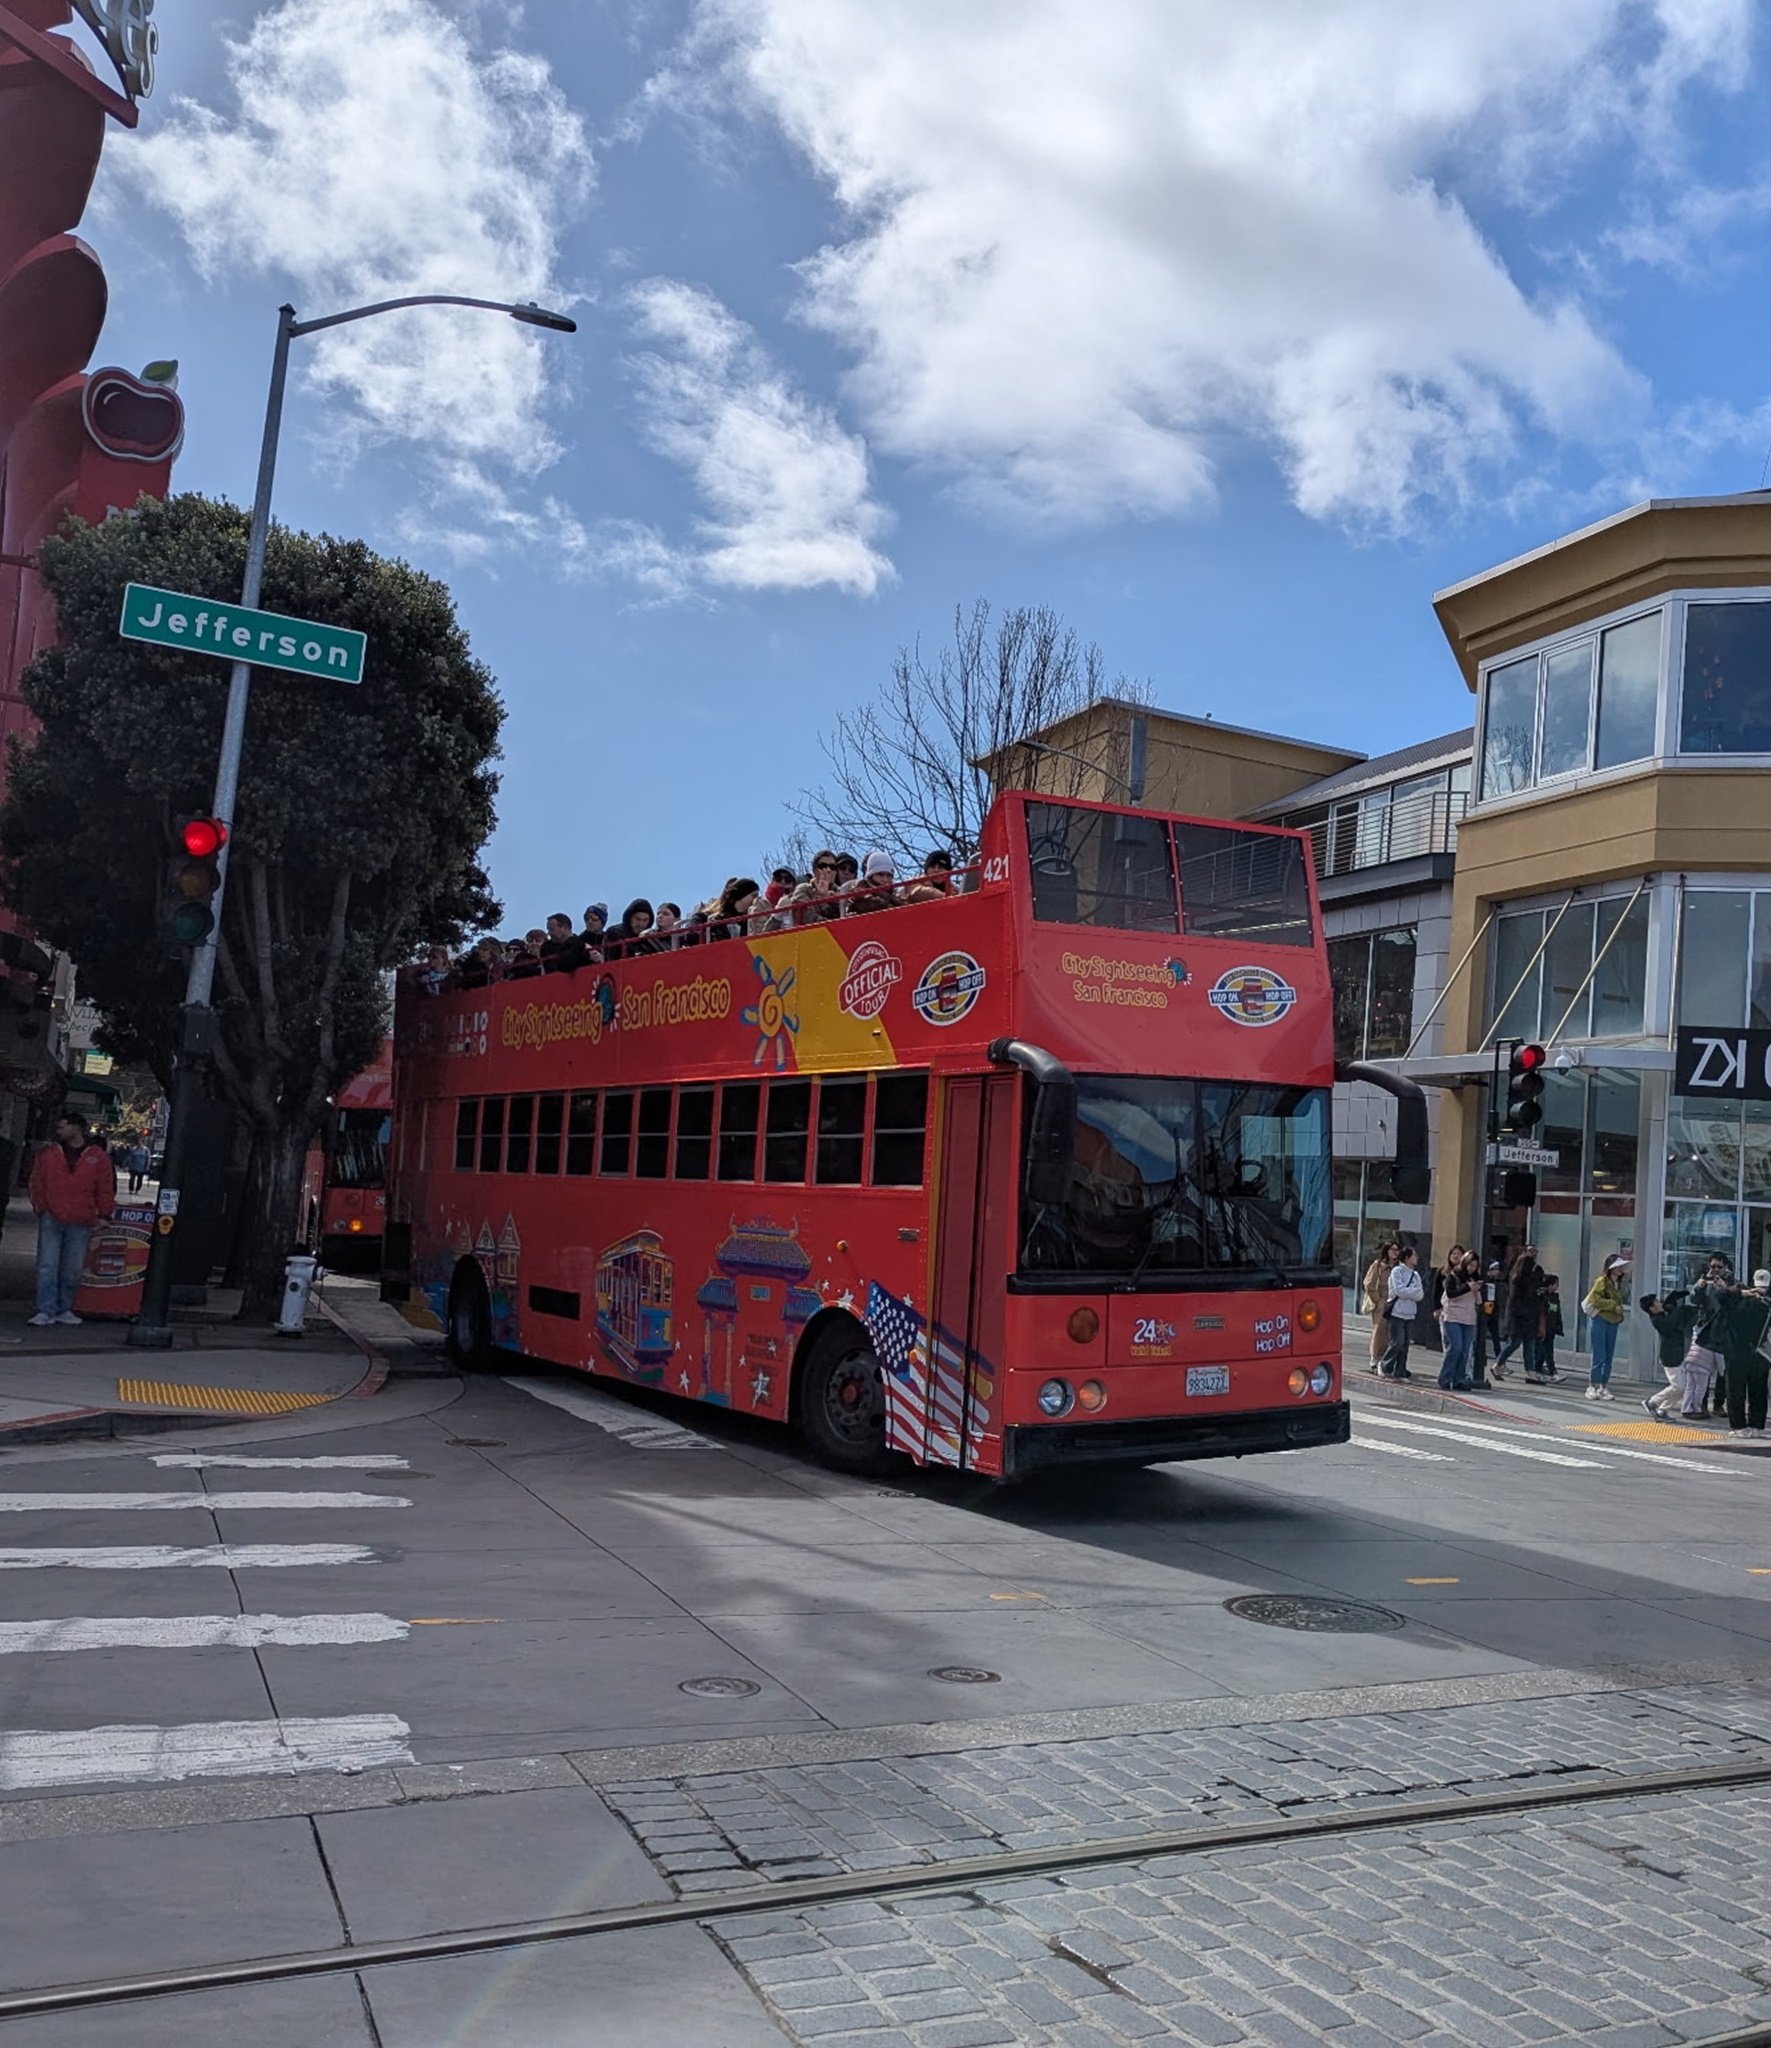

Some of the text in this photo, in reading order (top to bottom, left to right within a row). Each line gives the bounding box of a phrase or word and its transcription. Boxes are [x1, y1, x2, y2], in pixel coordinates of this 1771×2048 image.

[138, 603, 349, 668] Jefferson
[983, 853, 1009, 882] 421
[844, 960, 899, 1005] OFFICIAL
[915, 973, 983, 1005] HOP ON HOP OFF
[1073, 980, 1168, 1008] San Francisco
[1265, 991, 1280, 1002] HOP
[1280, 990, 1294, 1001] OFF
[622, 985, 650, 1031] San
[653, 975, 731, 1027] Francisco
[861, 990, 886, 1014] TOUR
[1504, 1149, 1553, 1164] Jefferson
[121, 1210, 143, 1222] HOP
[1133, 1318, 1157, 1344] 24
[1276, 1332, 1291, 1348] Off
